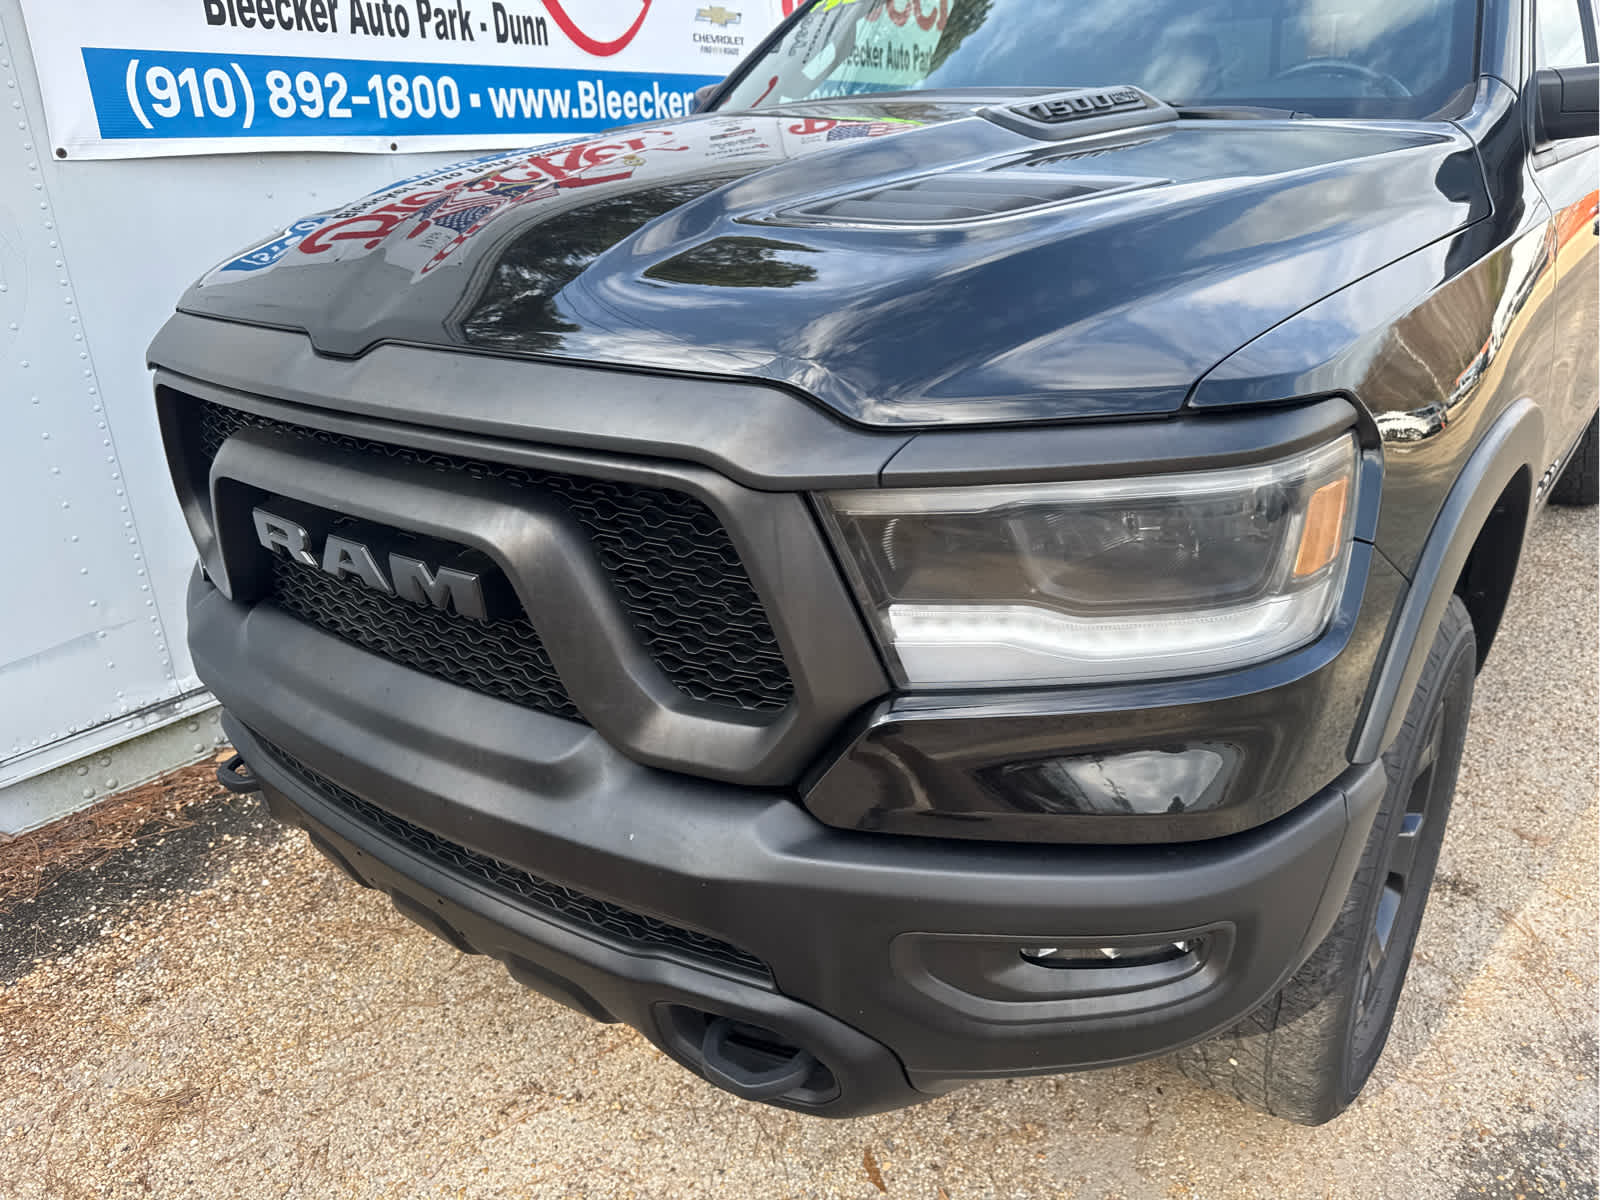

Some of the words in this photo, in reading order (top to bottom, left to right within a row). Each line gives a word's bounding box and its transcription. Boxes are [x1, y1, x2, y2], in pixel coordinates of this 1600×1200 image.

[203, 0, 338, 34] Bleecker
[350, 0, 410, 38] Auto
[416, 0, 475, 42] Park
[492, 2, 549, 46] Dunn
[692, 33, 744, 46] CHEVROLET
[887, 40, 911, 72] Auto
[126, 59, 255, 129] (910)
[265, 70, 461, 119] 892-1800
[1030, 94, 1115, 118] 1500
[252, 507, 488, 622] RAM
